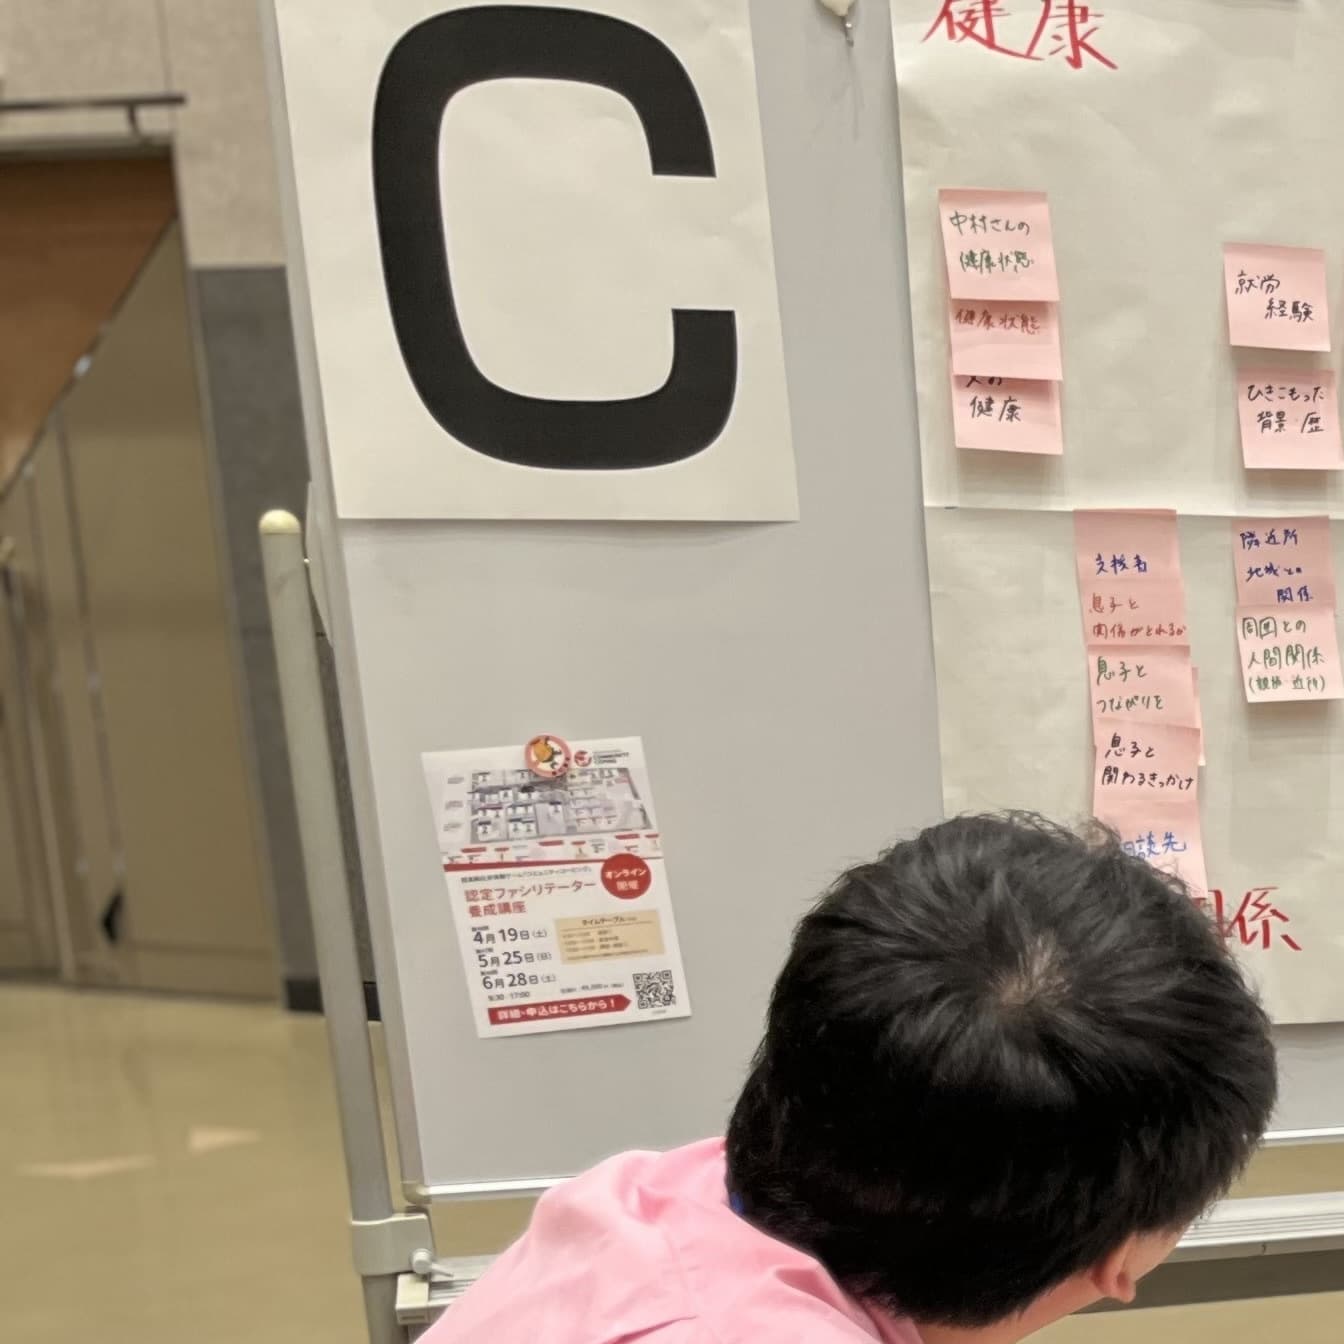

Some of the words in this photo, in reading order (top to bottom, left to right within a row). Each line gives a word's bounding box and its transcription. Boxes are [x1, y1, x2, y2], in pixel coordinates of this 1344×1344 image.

[921, 0, 1118, 69] 健康
[949, 210, 1030, 235] 中村さんの
[372, 4, 738, 471] C
[1235, 270, 1280, 294] 就労
[956, 309, 1040, 335] 健康状態
[1265, 298, 1313, 322] 経験
[1248, 385, 1324, 402] ひきこもった
[969, 395, 1021, 422] 健康
[1089, 592, 1140, 613] 息子と
[1242, 616, 1306, 640] 周囲との
[1248, 643, 1325, 669] 人間関係
[1097, 656, 1147, 685] 息子と
[1096, 695, 1164, 713] つながりを
[1105, 732, 1156, 758] 息子と
[1101, 766, 1194, 790] 関わるきっかけ
[605, 868, 647, 880] オンライン
[465, 880, 596, 902] 認定ファシリテーター
[1210, 886, 1302, 951] 係
